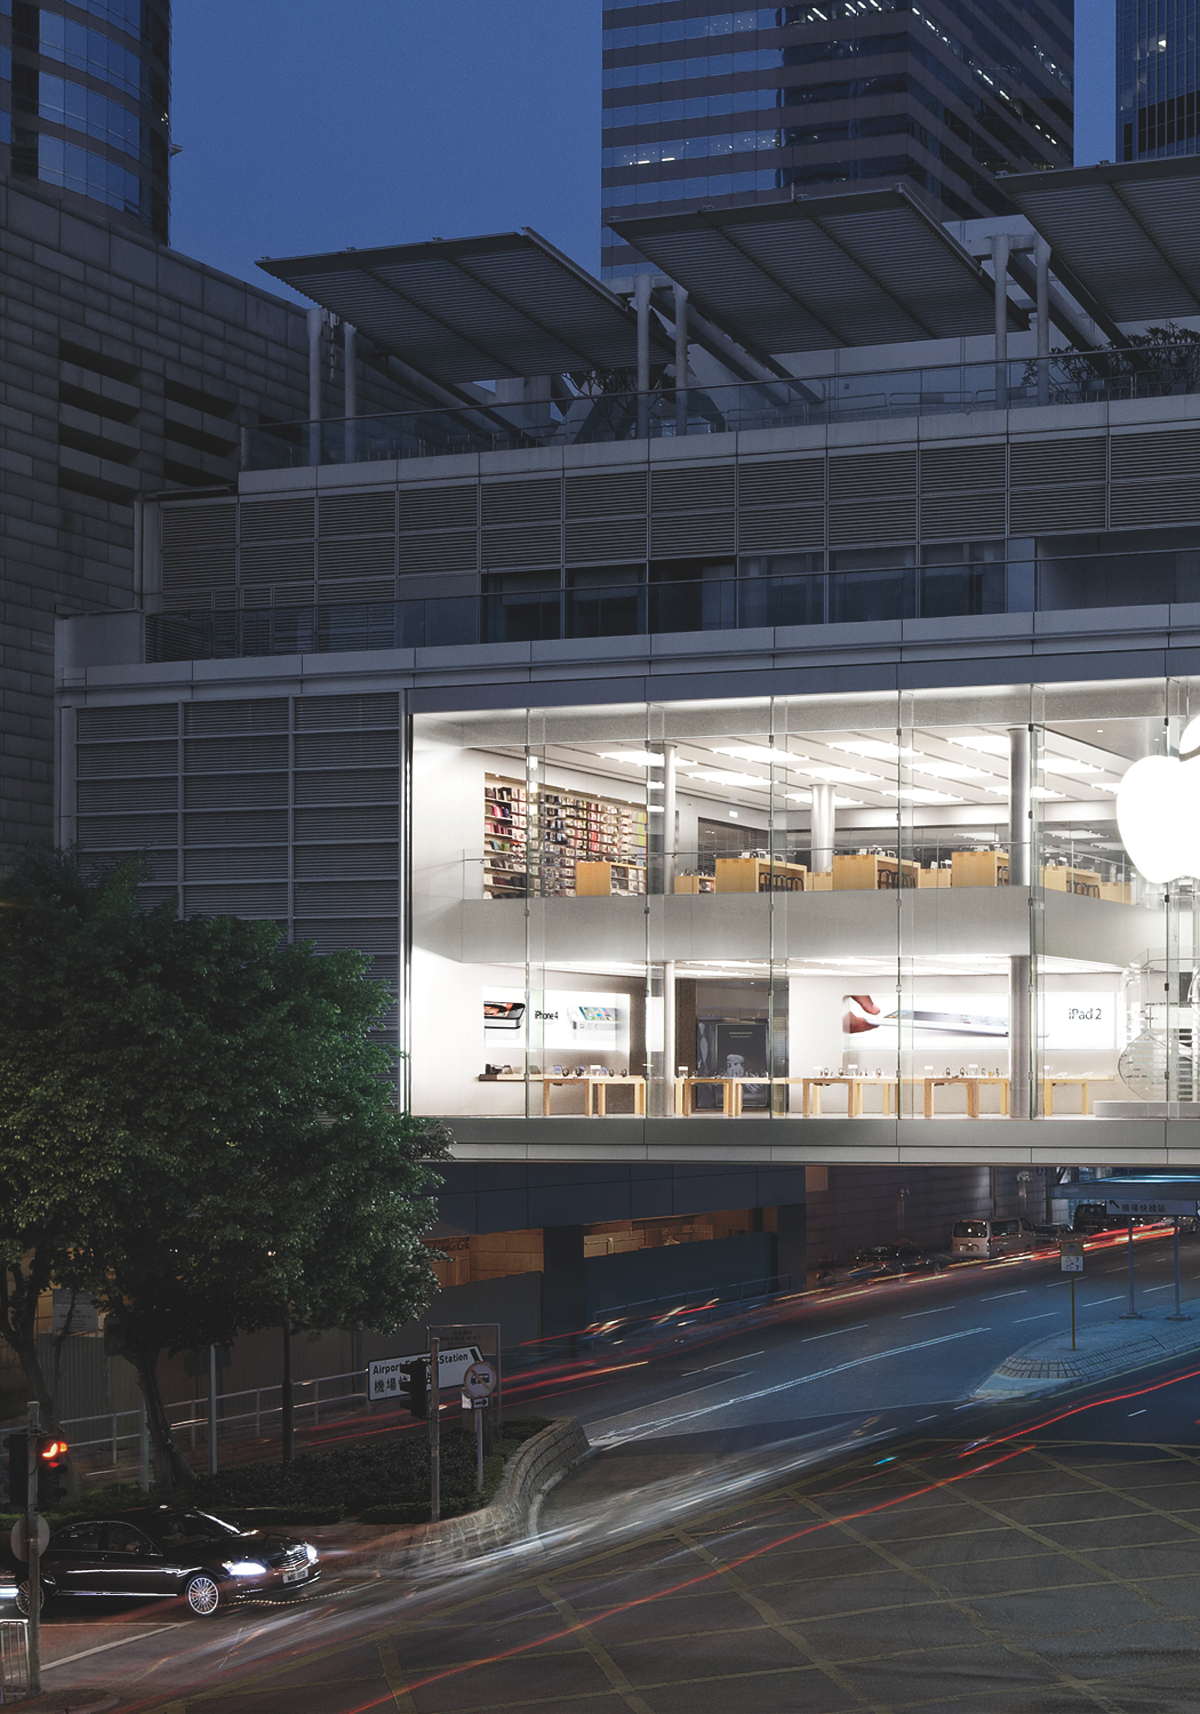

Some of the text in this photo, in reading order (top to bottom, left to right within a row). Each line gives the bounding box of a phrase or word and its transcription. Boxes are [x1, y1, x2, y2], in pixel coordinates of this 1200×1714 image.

[534, 1010, 554, 1021] iPhone
[1068, 1008, 1102, 1020] iPad 2
[373, 1363, 401, 1376] Airpor
[439, 1352, 469, 1365] Station
